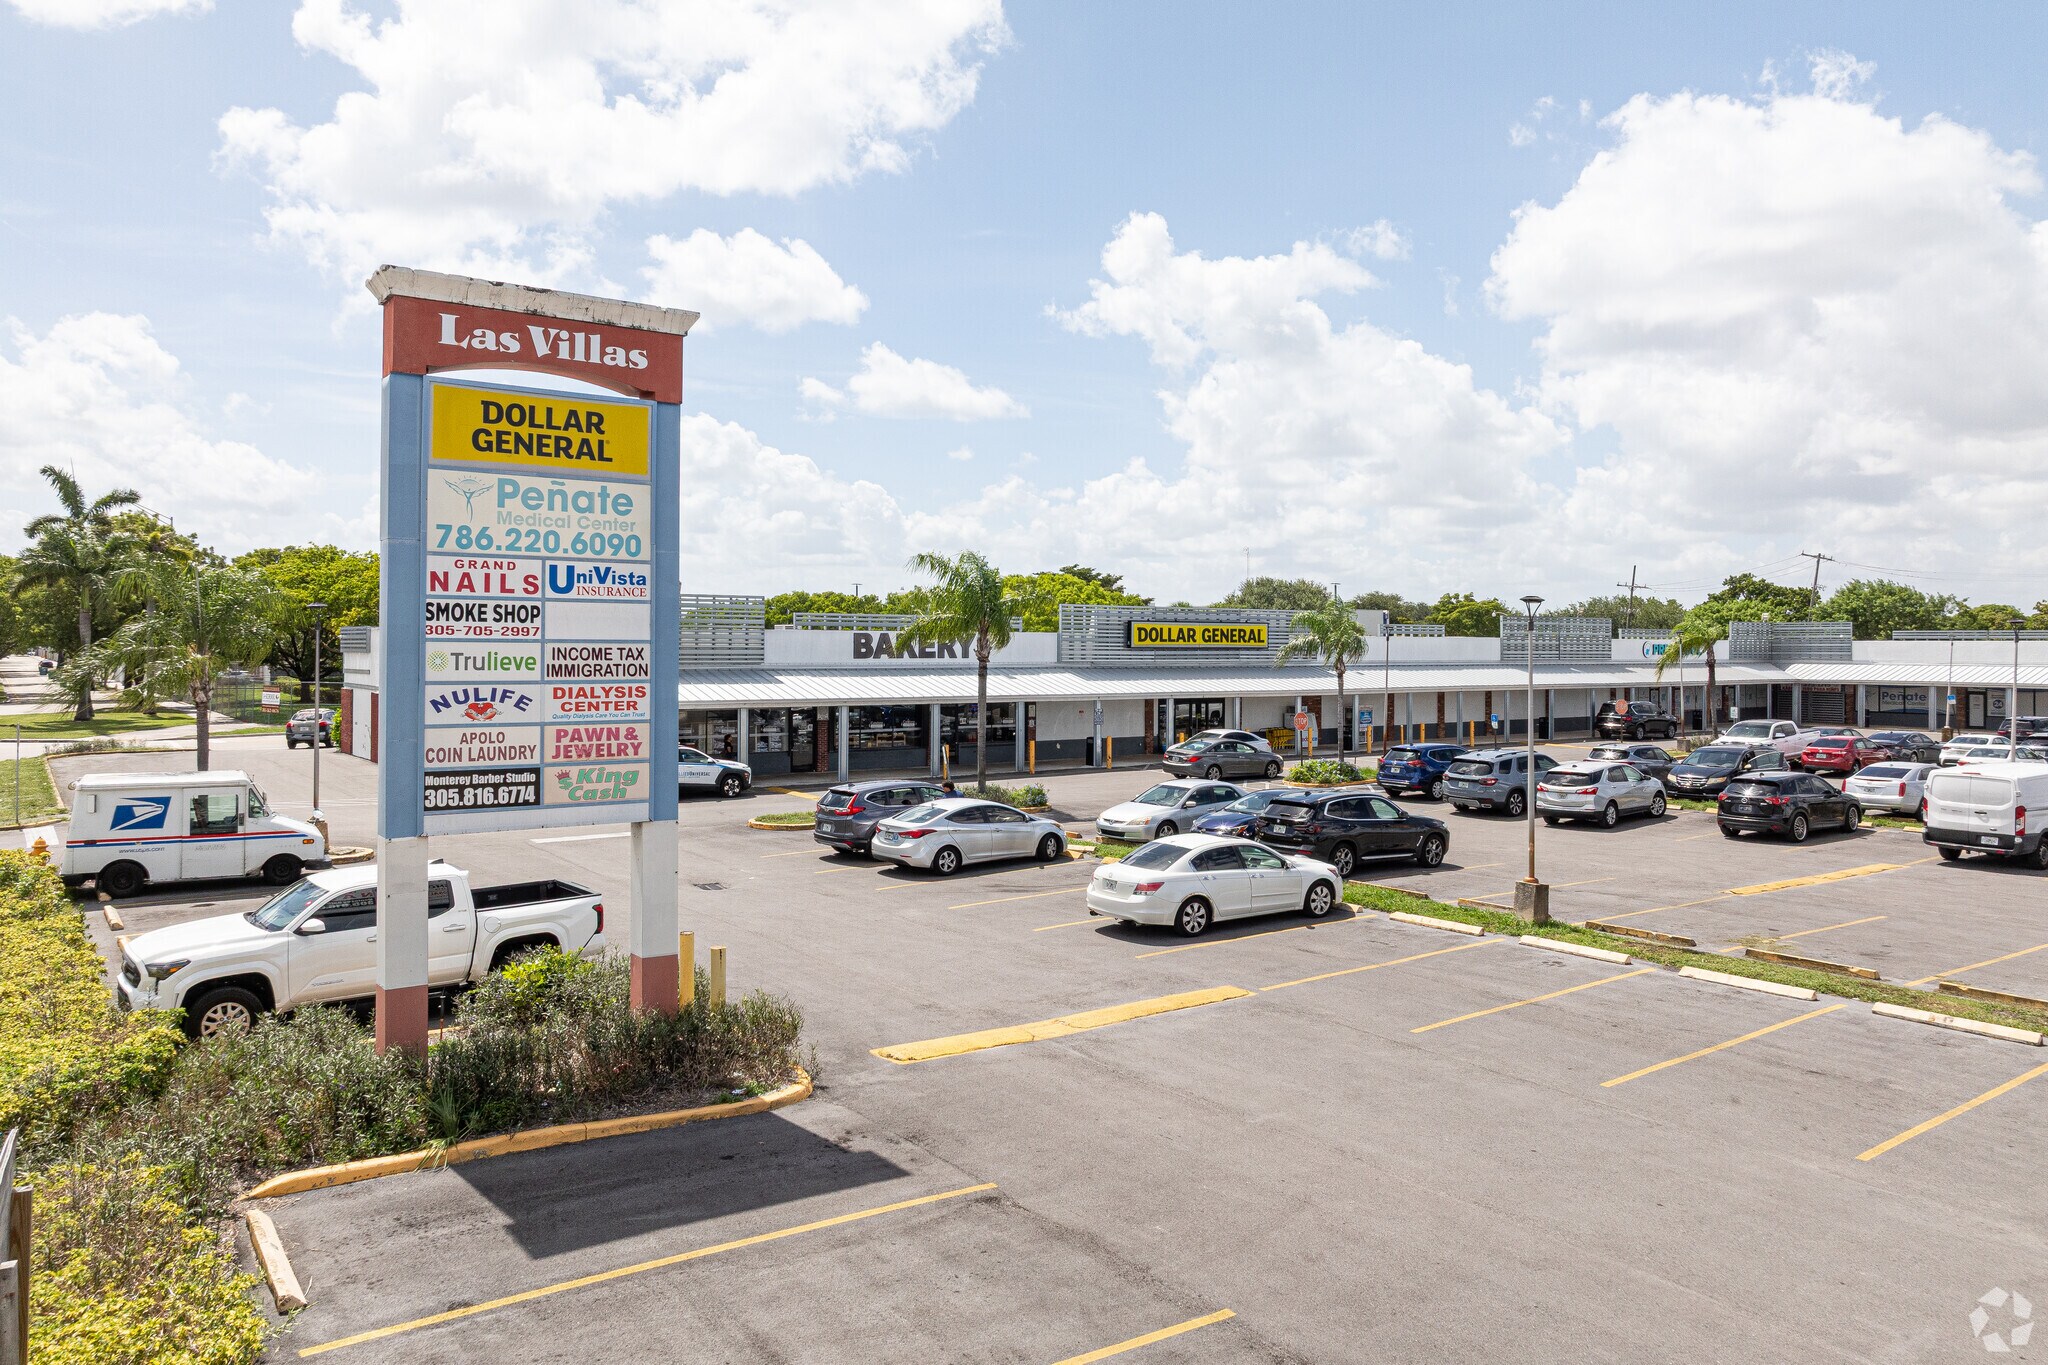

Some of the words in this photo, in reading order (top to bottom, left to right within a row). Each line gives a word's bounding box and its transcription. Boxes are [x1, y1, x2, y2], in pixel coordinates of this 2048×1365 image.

[438, 312, 521, 354] Las
[526, 325, 649, 370] Villas
[480, 400, 606, 435] DOLLAR
[472, 428, 613, 463] GENERAL
[497, 477, 634, 517] Peñate
[497, 510, 570, 529] Medical
[577, 515, 636, 532] Center
[435, 524, 641, 558] 786.220.6090
[454, 559, 516, 571] GRAND
[429, 570, 540, 595] NAILS
[549, 564, 647, 594] UniVista
[576, 585, 647, 597] INSURANCE
[426, 602, 488, 622] SMOKE
[492, 604, 541, 624] SHOP
[426, 625, 540, 637] 305-705-2997
[1136, 626, 1197, 644] DOLLAR
[1201, 628, 1265, 644] GENERAL
[450, 651, 537, 671] Trulieve
[552, 647, 613, 661] INCOME
[617, 647, 645, 661] TAX
[546, 663, 649, 678] IMMIGRATION
[429, 687, 533, 714] NULIFE
[552, 685, 647, 699] DIALYSIS
[560, 700, 639, 712] CENTER
[459, 731, 506, 745] APOLO
[555, 727, 621, 743] PAWN
[623, 726, 639, 741] &
[425, 747, 463, 764] COIN
[468, 744, 537, 762] LAUNDRY
[551, 741, 643, 760] JEWELRY
[425, 774, 471, 786] Monterey
[472, 773, 505, 785] Barber
[506, 772, 536, 783] Studio
[576, 767, 640, 786] King
[425, 785, 536, 808] 305.816.6774
[568, 782, 628, 801] Cash
